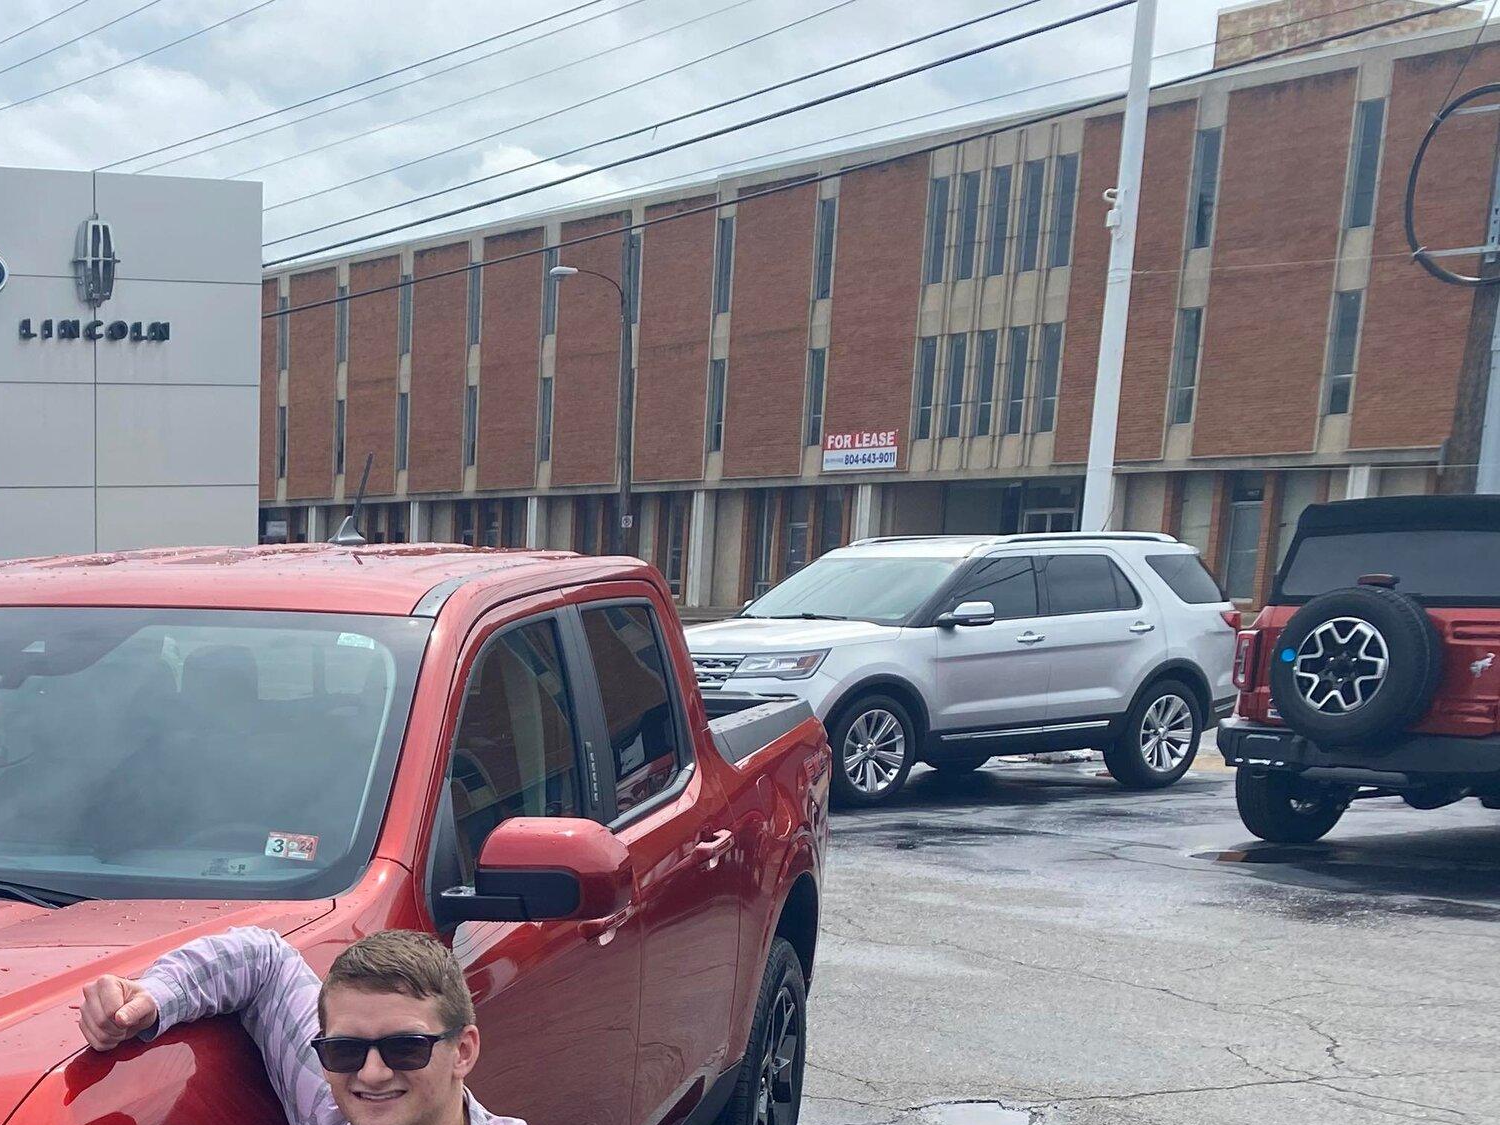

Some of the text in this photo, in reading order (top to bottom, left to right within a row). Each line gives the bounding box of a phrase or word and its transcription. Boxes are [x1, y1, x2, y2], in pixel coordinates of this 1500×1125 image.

[18, 318, 171, 342] LINCOLN
[828, 431, 896, 449] FOR LEASE
[844, 451, 896, 465] 804-643-9011
[272, 838, 314, 853] 3 24
